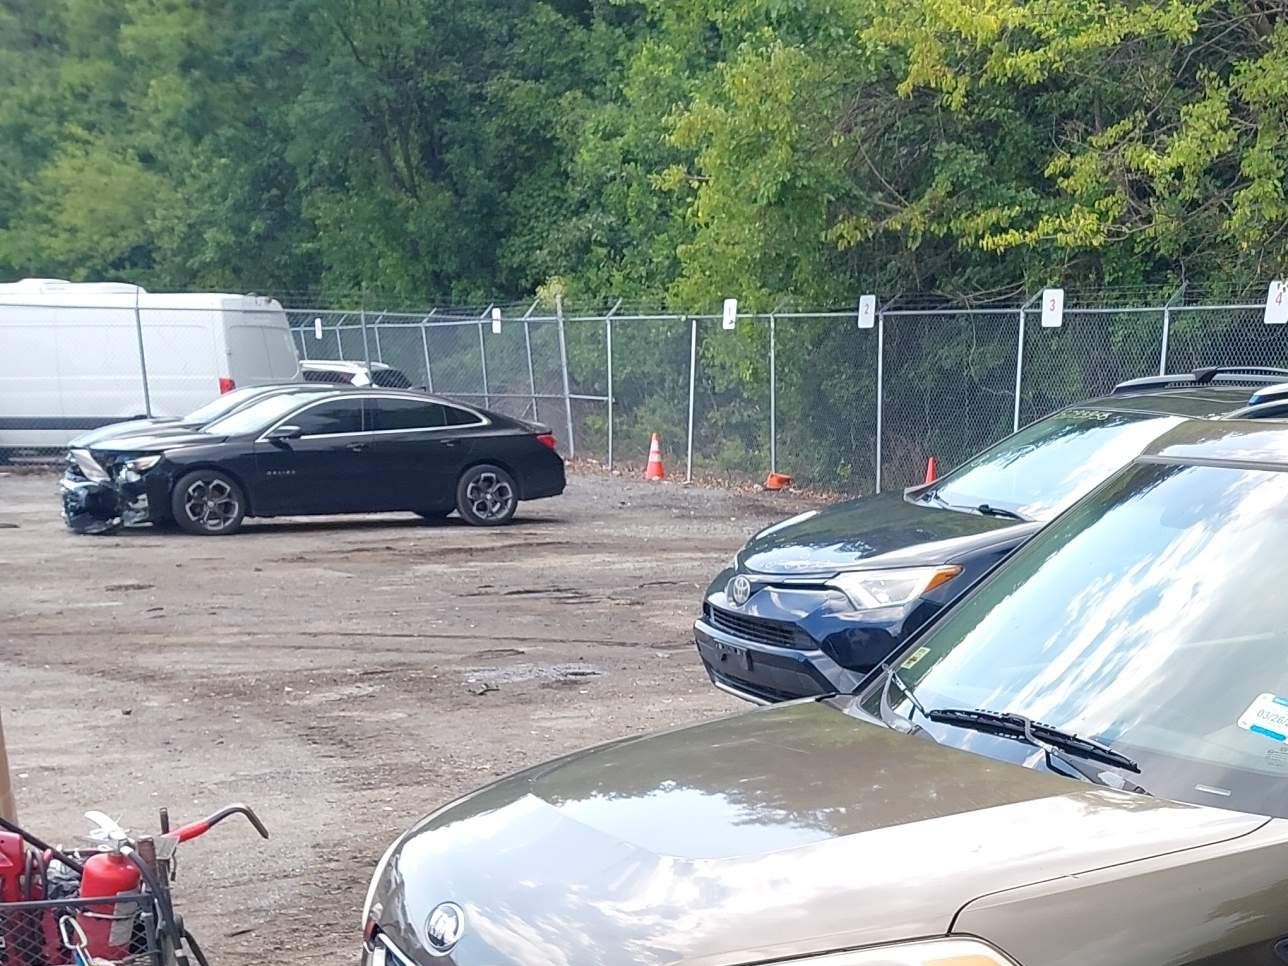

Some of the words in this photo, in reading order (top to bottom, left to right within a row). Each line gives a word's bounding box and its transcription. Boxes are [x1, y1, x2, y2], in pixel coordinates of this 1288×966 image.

[1049, 298, 1056, 312] 3
[1274, 292, 1283, 306] 4
[864, 303, 870, 314] 2
